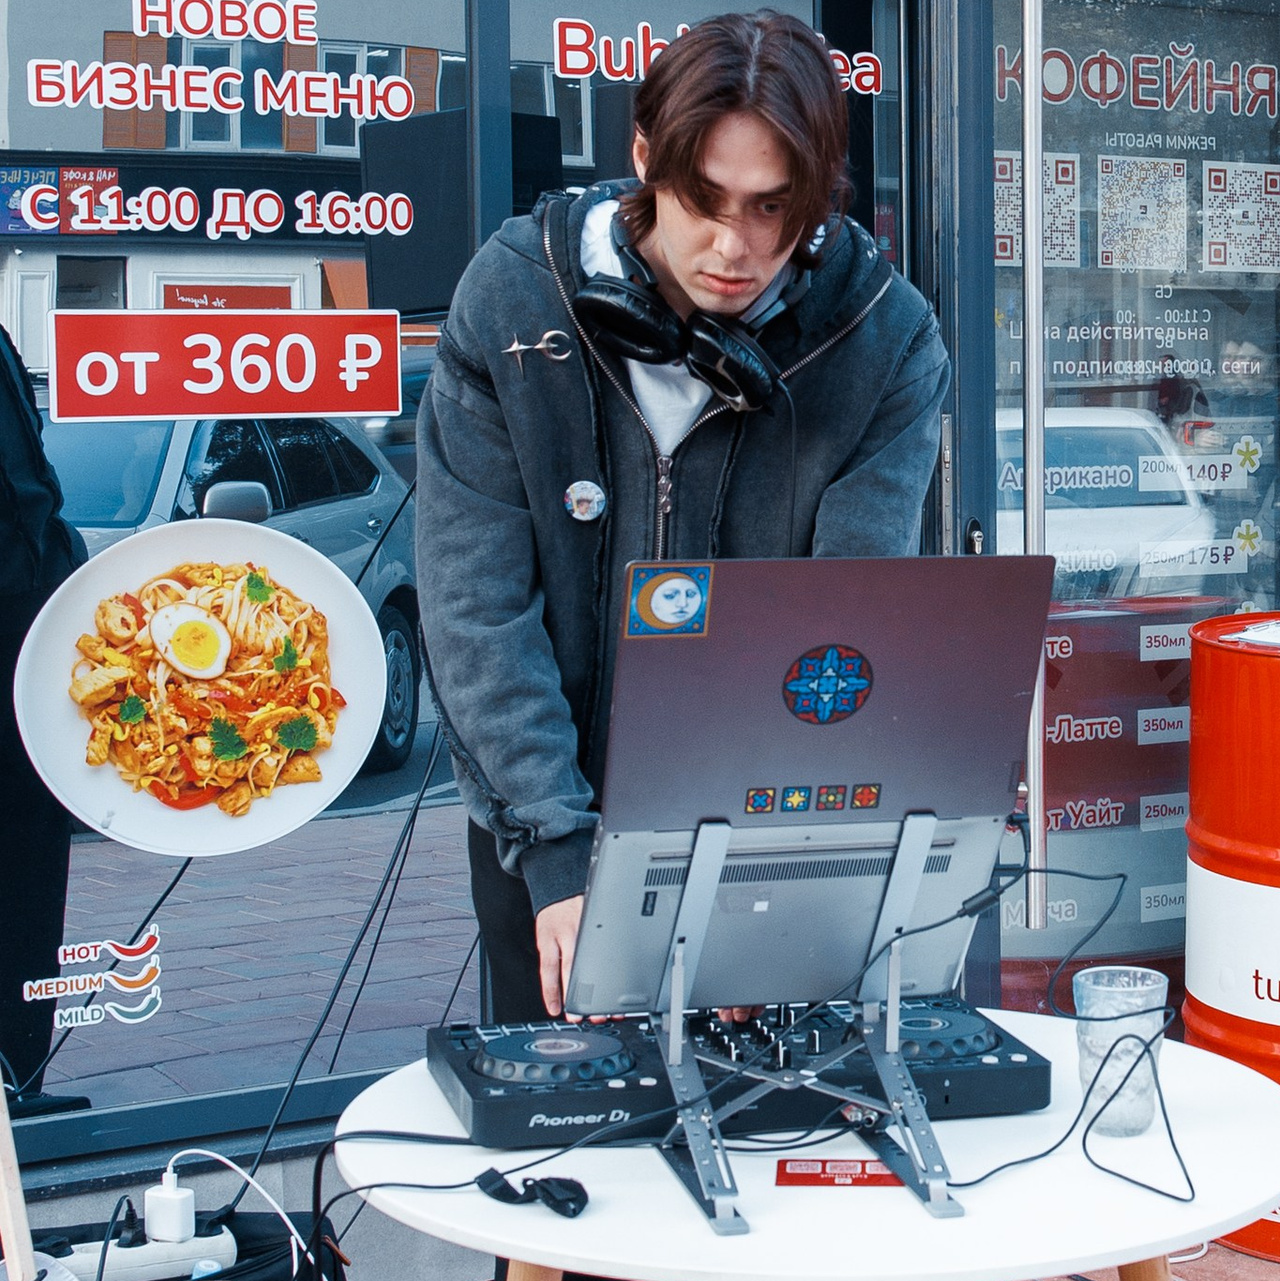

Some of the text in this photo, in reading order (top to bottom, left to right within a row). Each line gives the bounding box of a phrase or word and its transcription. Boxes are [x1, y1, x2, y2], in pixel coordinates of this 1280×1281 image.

[820, 33, 883, 95] ea
[28, 60, 415, 120] БИЗНЕС МЕНЮ
[995, 42, 1279, 119] КОФЕЙНЯ
[73, 186, 199, 231] 11:00
[208, 189, 284, 238] ДО
[297, 191, 414, 235] 16:00
[1067, 322, 1209, 344] действительна
[75, 332, 383, 397] от 360 ₽
[1222, 361, 1261, 375] сети
[999, 463, 1133, 494] Арикано
[1145, 635, 1186, 649] 350мл
[1143, 719, 1184, 733] 350мл
[1067, 800, 1125, 827] Уайт
[1144, 804, 1185, 818] 250мл
[1003, 894, 1185, 928] Мча 350мл
[61, 945, 102, 961] HOT
[27, 976, 104, 998] MEDIUM
[57, 1008, 104, 1026] MILD
[529, 1113, 605, 1128] Pioneer
